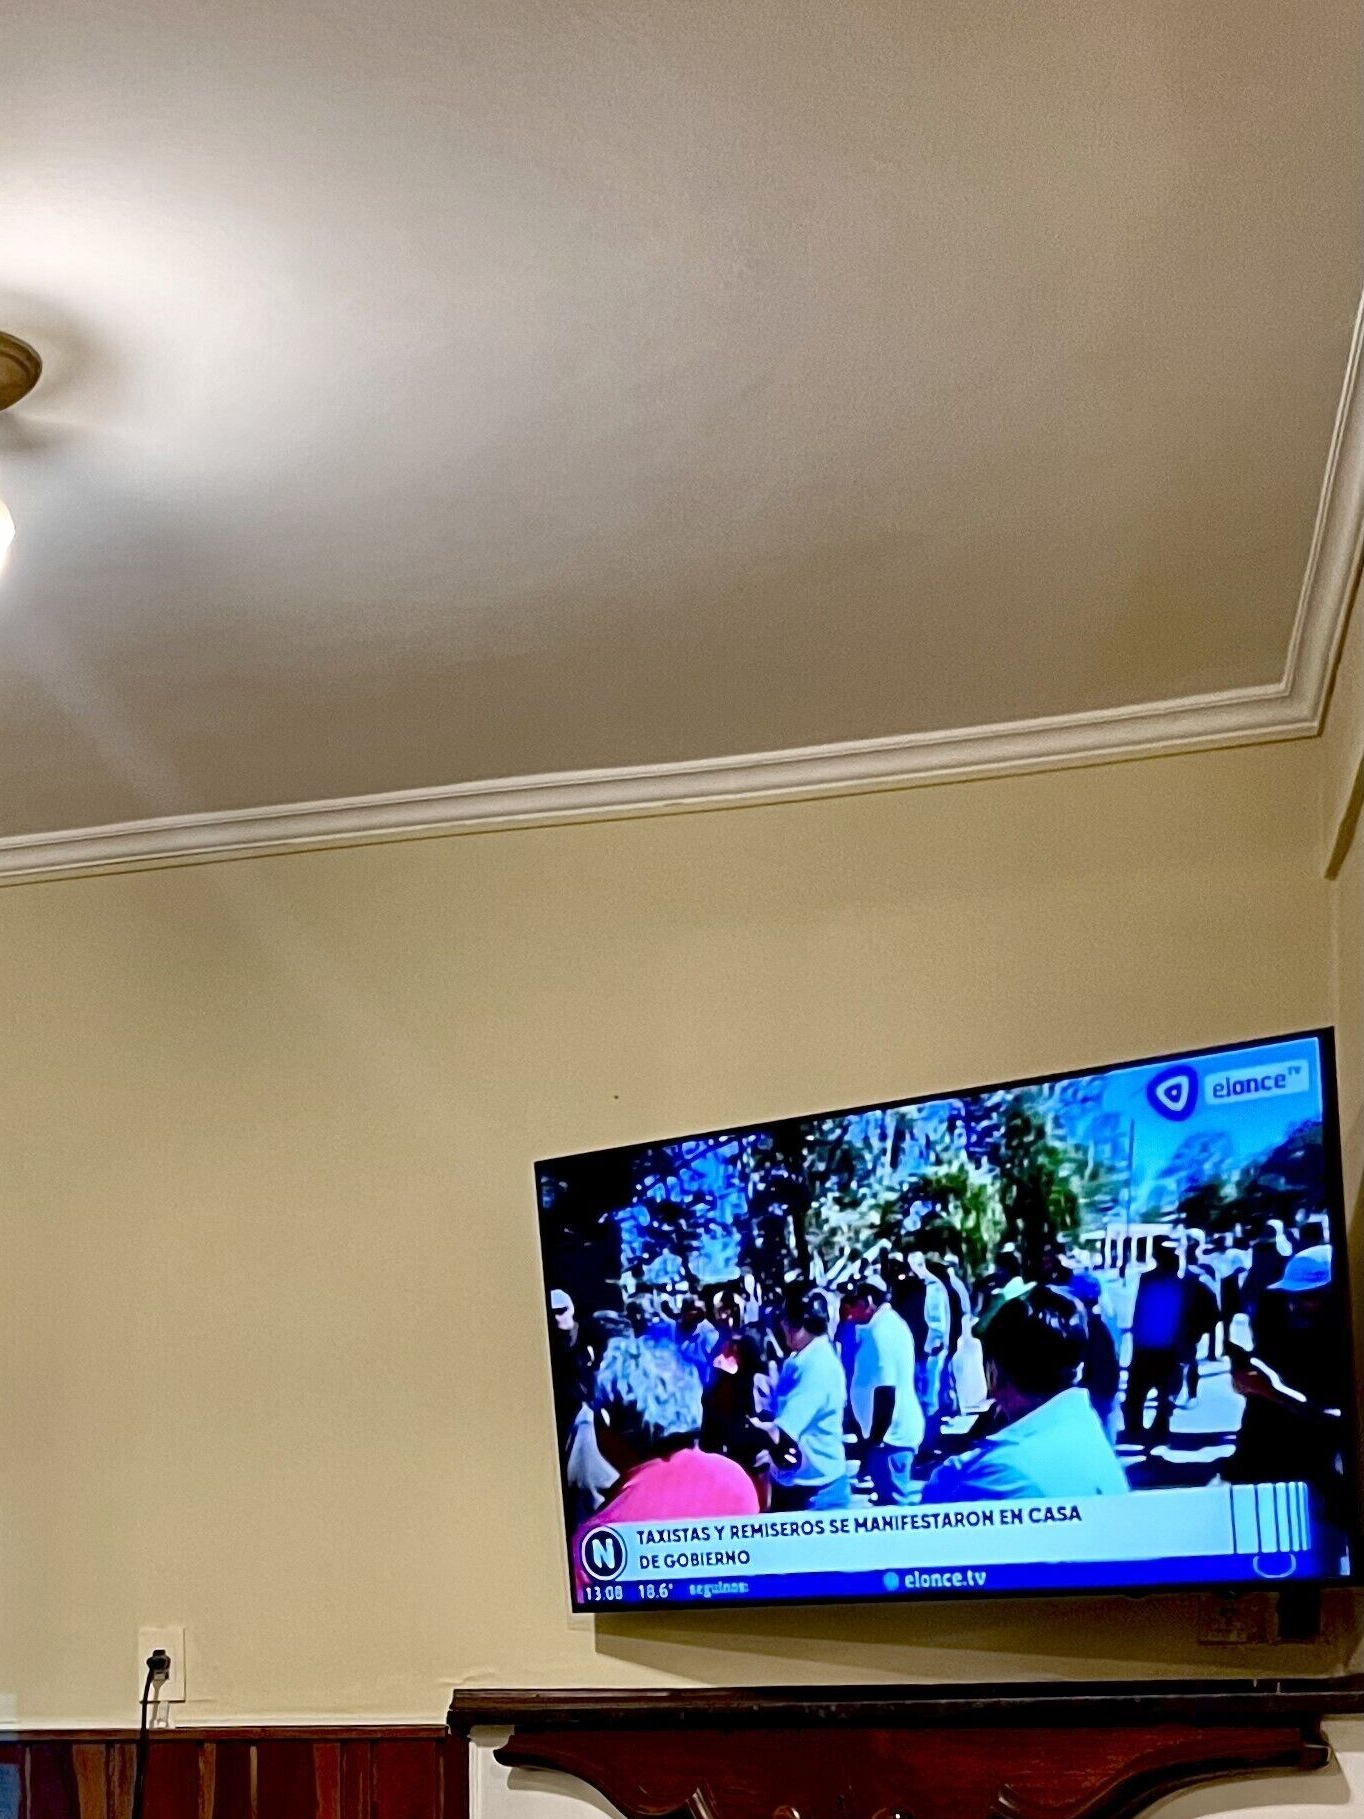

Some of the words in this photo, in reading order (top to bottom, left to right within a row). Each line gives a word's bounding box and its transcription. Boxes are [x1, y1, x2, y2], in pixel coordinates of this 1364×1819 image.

[637, 1526, 711, 1545] TAXISTAS
[714, 1525, 725, 1541] Y
[730, 1520, 825, 1539] REMISEROS
[829, 1518, 850, 1534] SE
[854, 1511, 994, 1533] MANIFESTARON
[1000, 1508, 1023, 1525] EN
[1028, 1505, 1082, 1524] CASA
[592, 1538, 616, 1570] N
[639, 1555, 660, 1570] DE
[663, 1549, 750, 1569] GOBIERNO
[904, 1570, 987, 1588] elonce.tv
